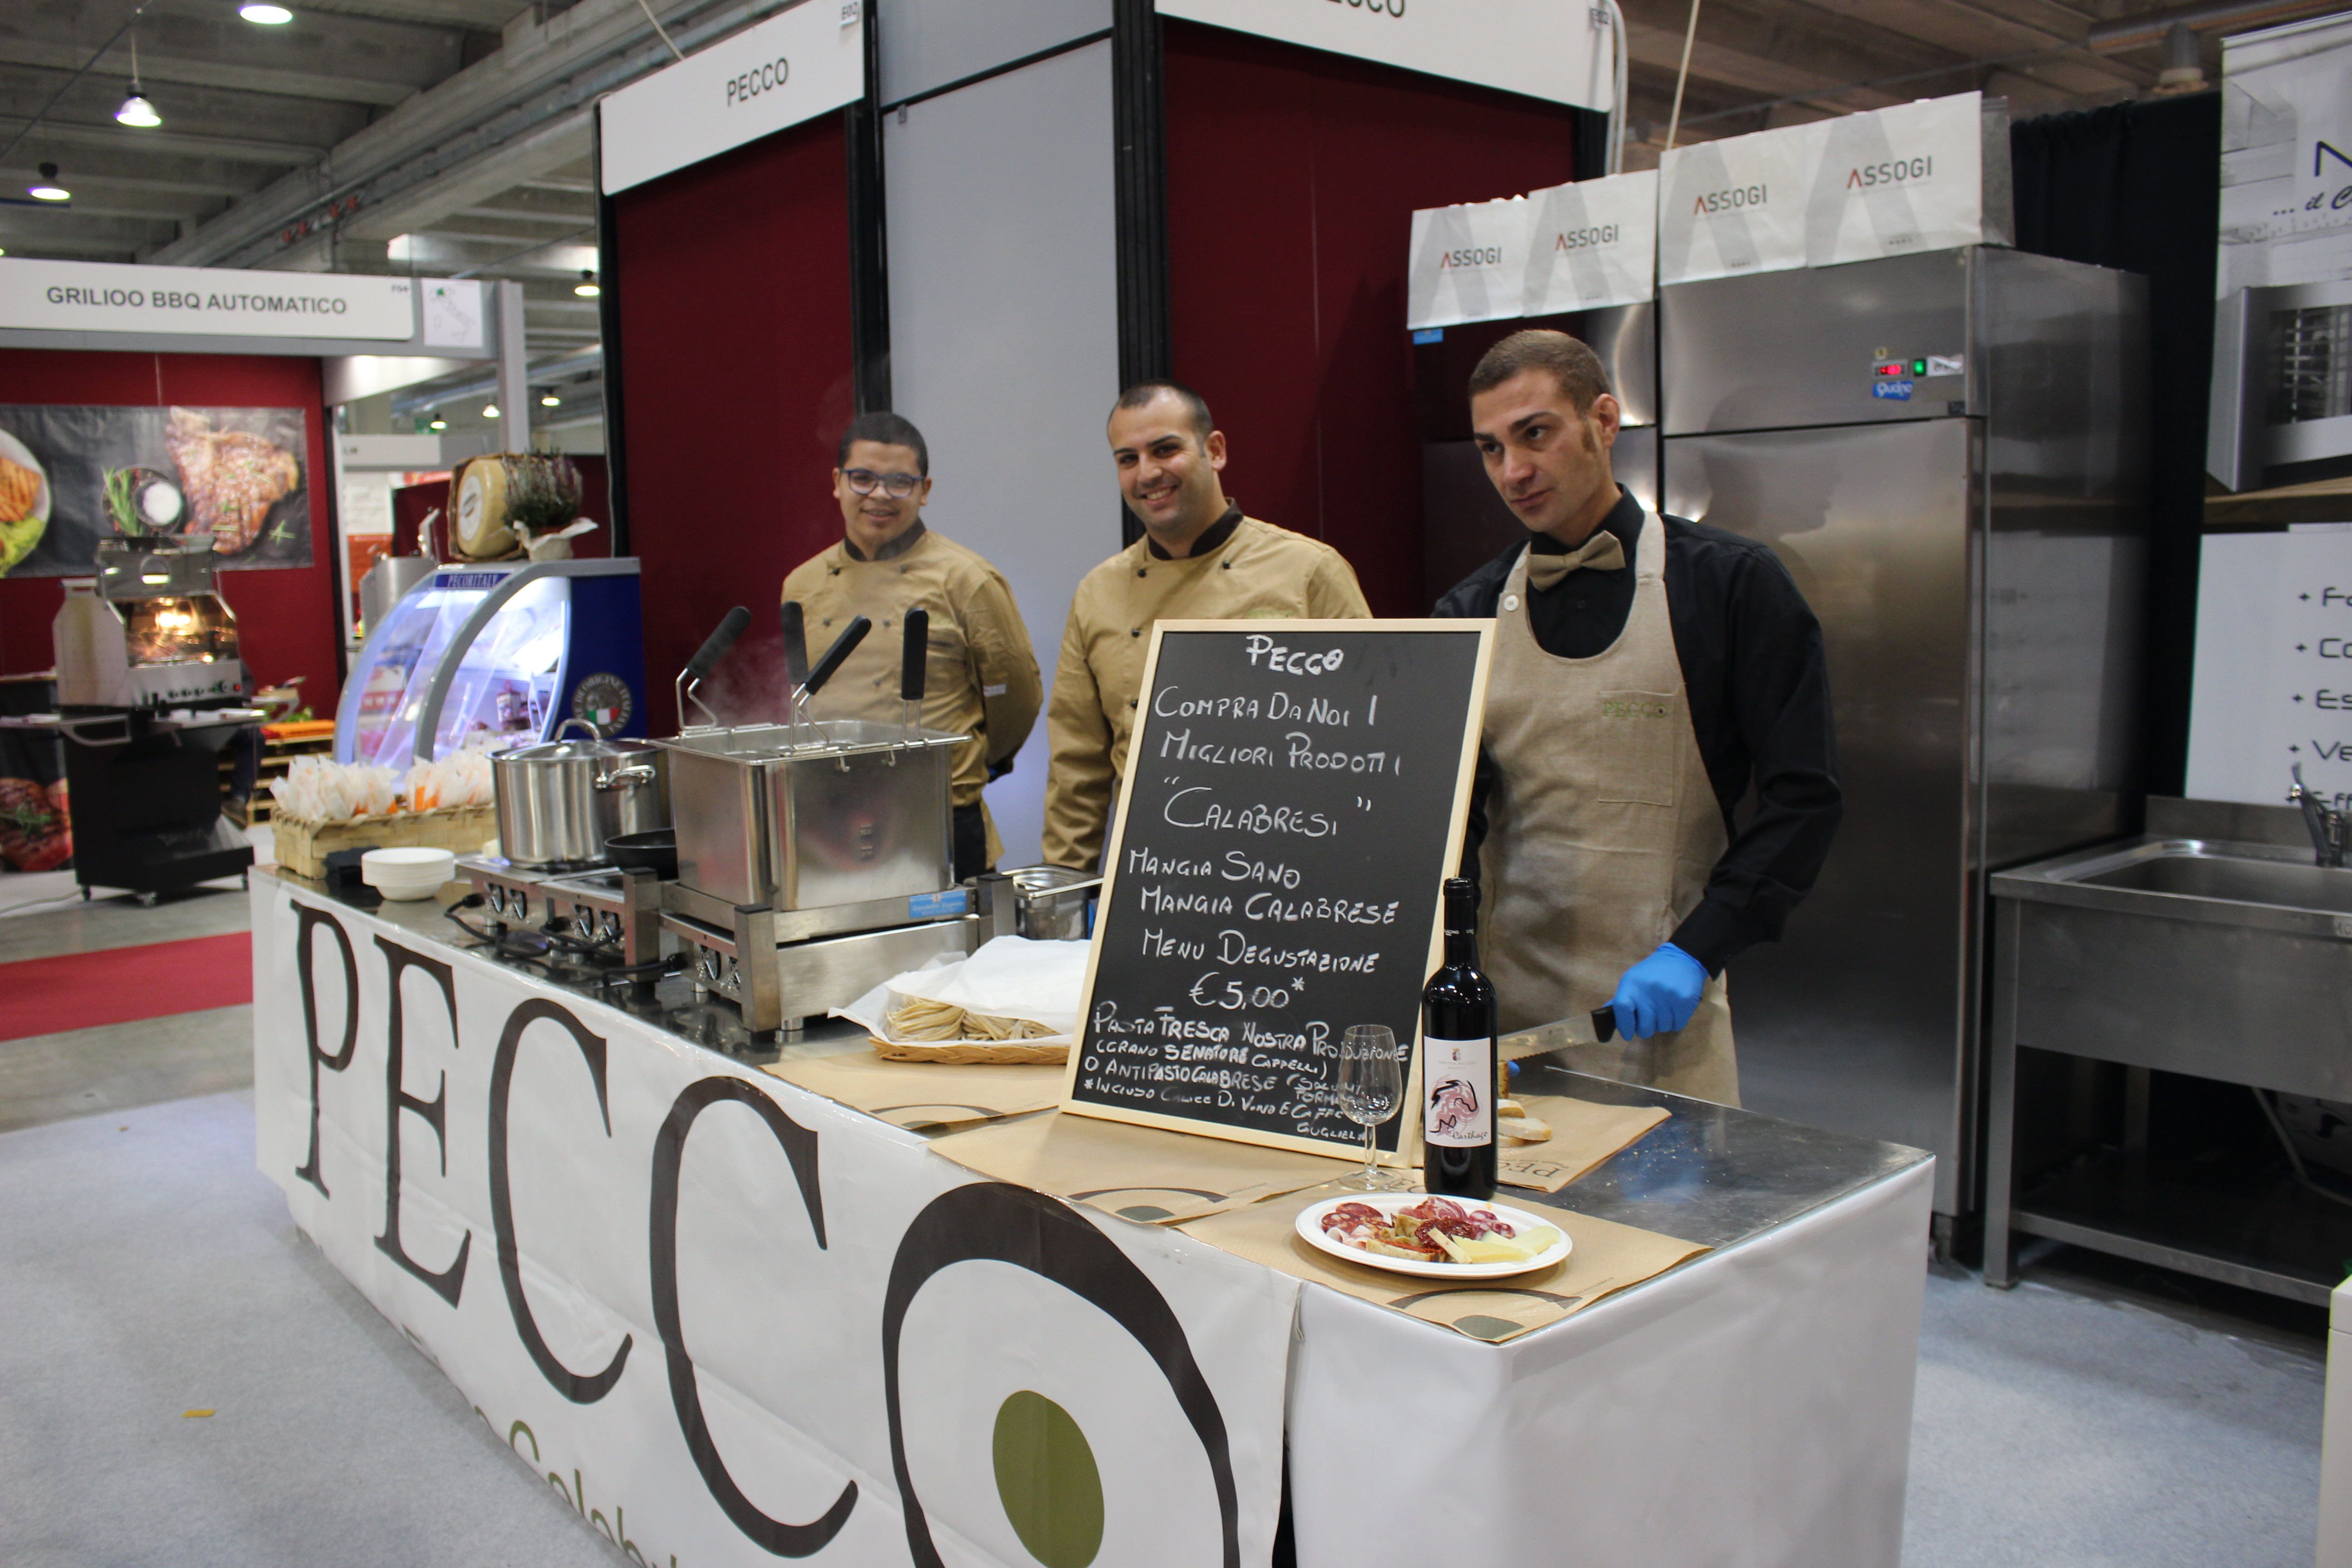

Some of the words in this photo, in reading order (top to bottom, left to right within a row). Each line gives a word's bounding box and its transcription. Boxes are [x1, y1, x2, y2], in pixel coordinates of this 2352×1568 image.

[727, 57, 788, 107] PECCO
[1847, 156, 1933, 189] ASSOGI
[1694, 184, 1767, 215] ASSOGI
[1555, 224, 1619, 251] ASSOGI
[1440, 246, 1502, 269] ASSOGI
[152, 291, 200, 309] BBQ
[207, 293, 347, 314] AUTOMATICO
[1155, 686, 1259, 720] COMPRA
[1160, 728, 1273, 767] MIGLIORI
[1129, 847, 1212, 876] MANGIA
[1221, 850, 1301, 889] SANO
[1140, 886, 1233, 916] MANGIA
[1245, 892, 1399, 926] CALABRESE
[1142, 928, 1205, 959] MENU
[1216, 929, 1380, 974] DEGUSTAZIONE
[1241, 1021, 1307, 1051] NOSTRA
